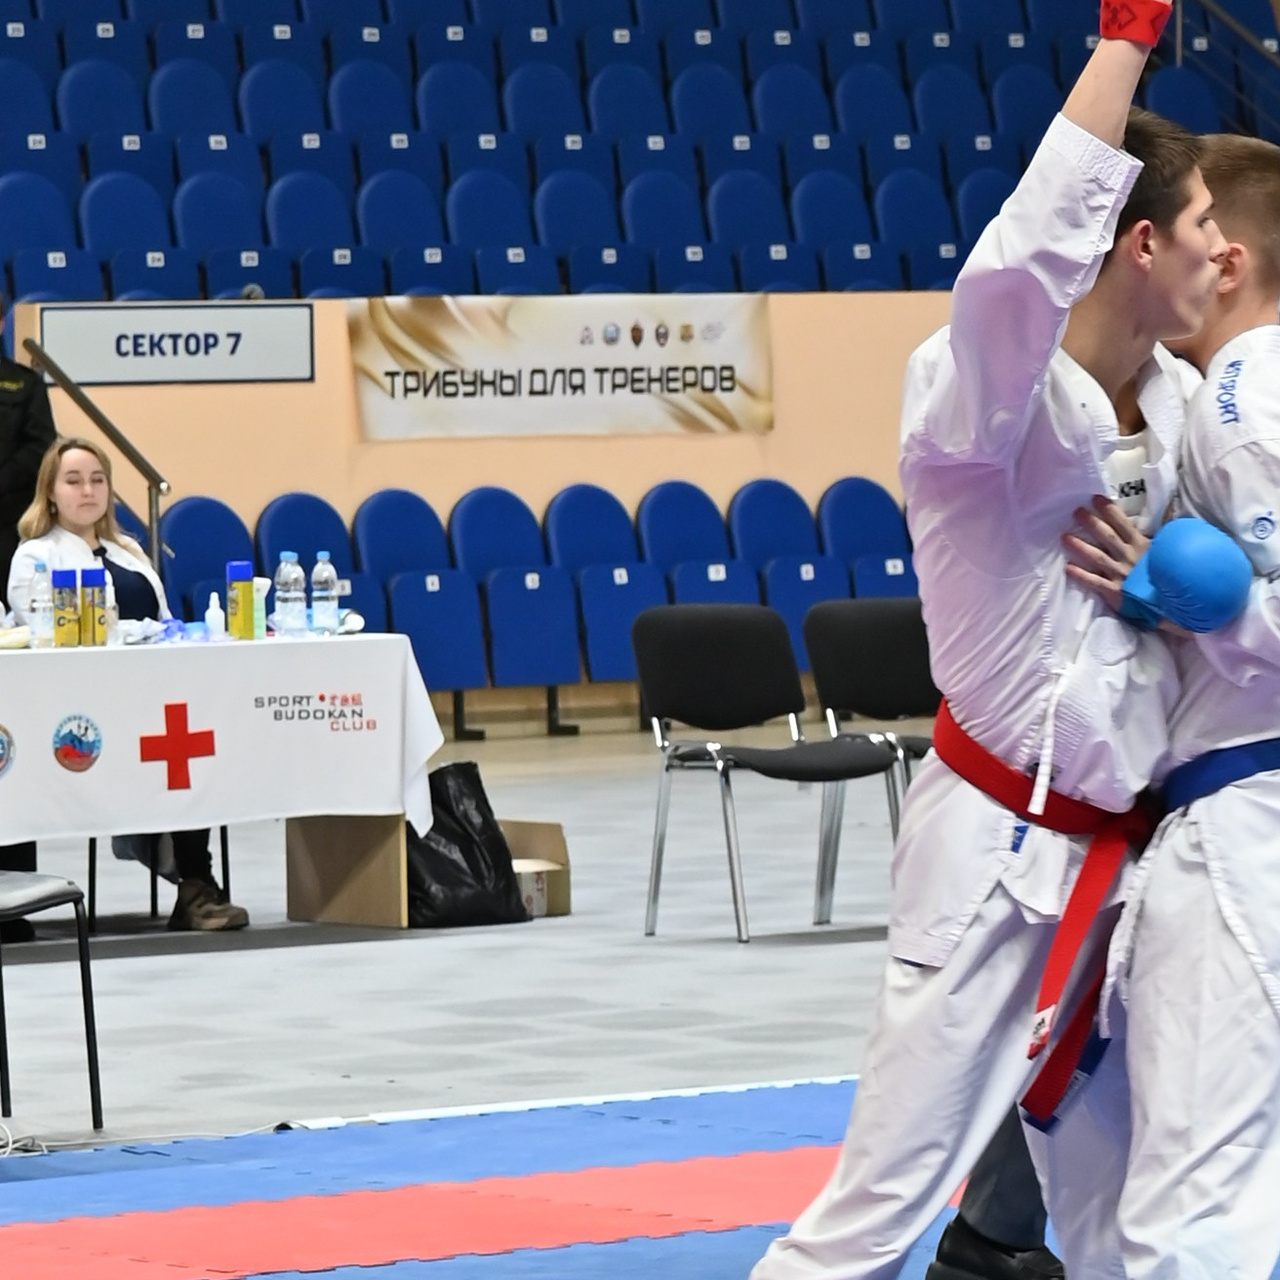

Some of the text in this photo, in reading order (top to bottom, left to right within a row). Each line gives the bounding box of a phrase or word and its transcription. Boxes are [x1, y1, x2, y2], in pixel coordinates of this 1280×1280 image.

[115, 332, 243, 357] СЕКТОР 7
[384, 365, 737, 399] ТРИБУНЫ ДЛЯ ТРЕНЕРОВ
[254, 694, 313, 709] SPORT
[273, 708, 364, 721] BUDOKAN
[329, 718, 377, 732] CLUB
